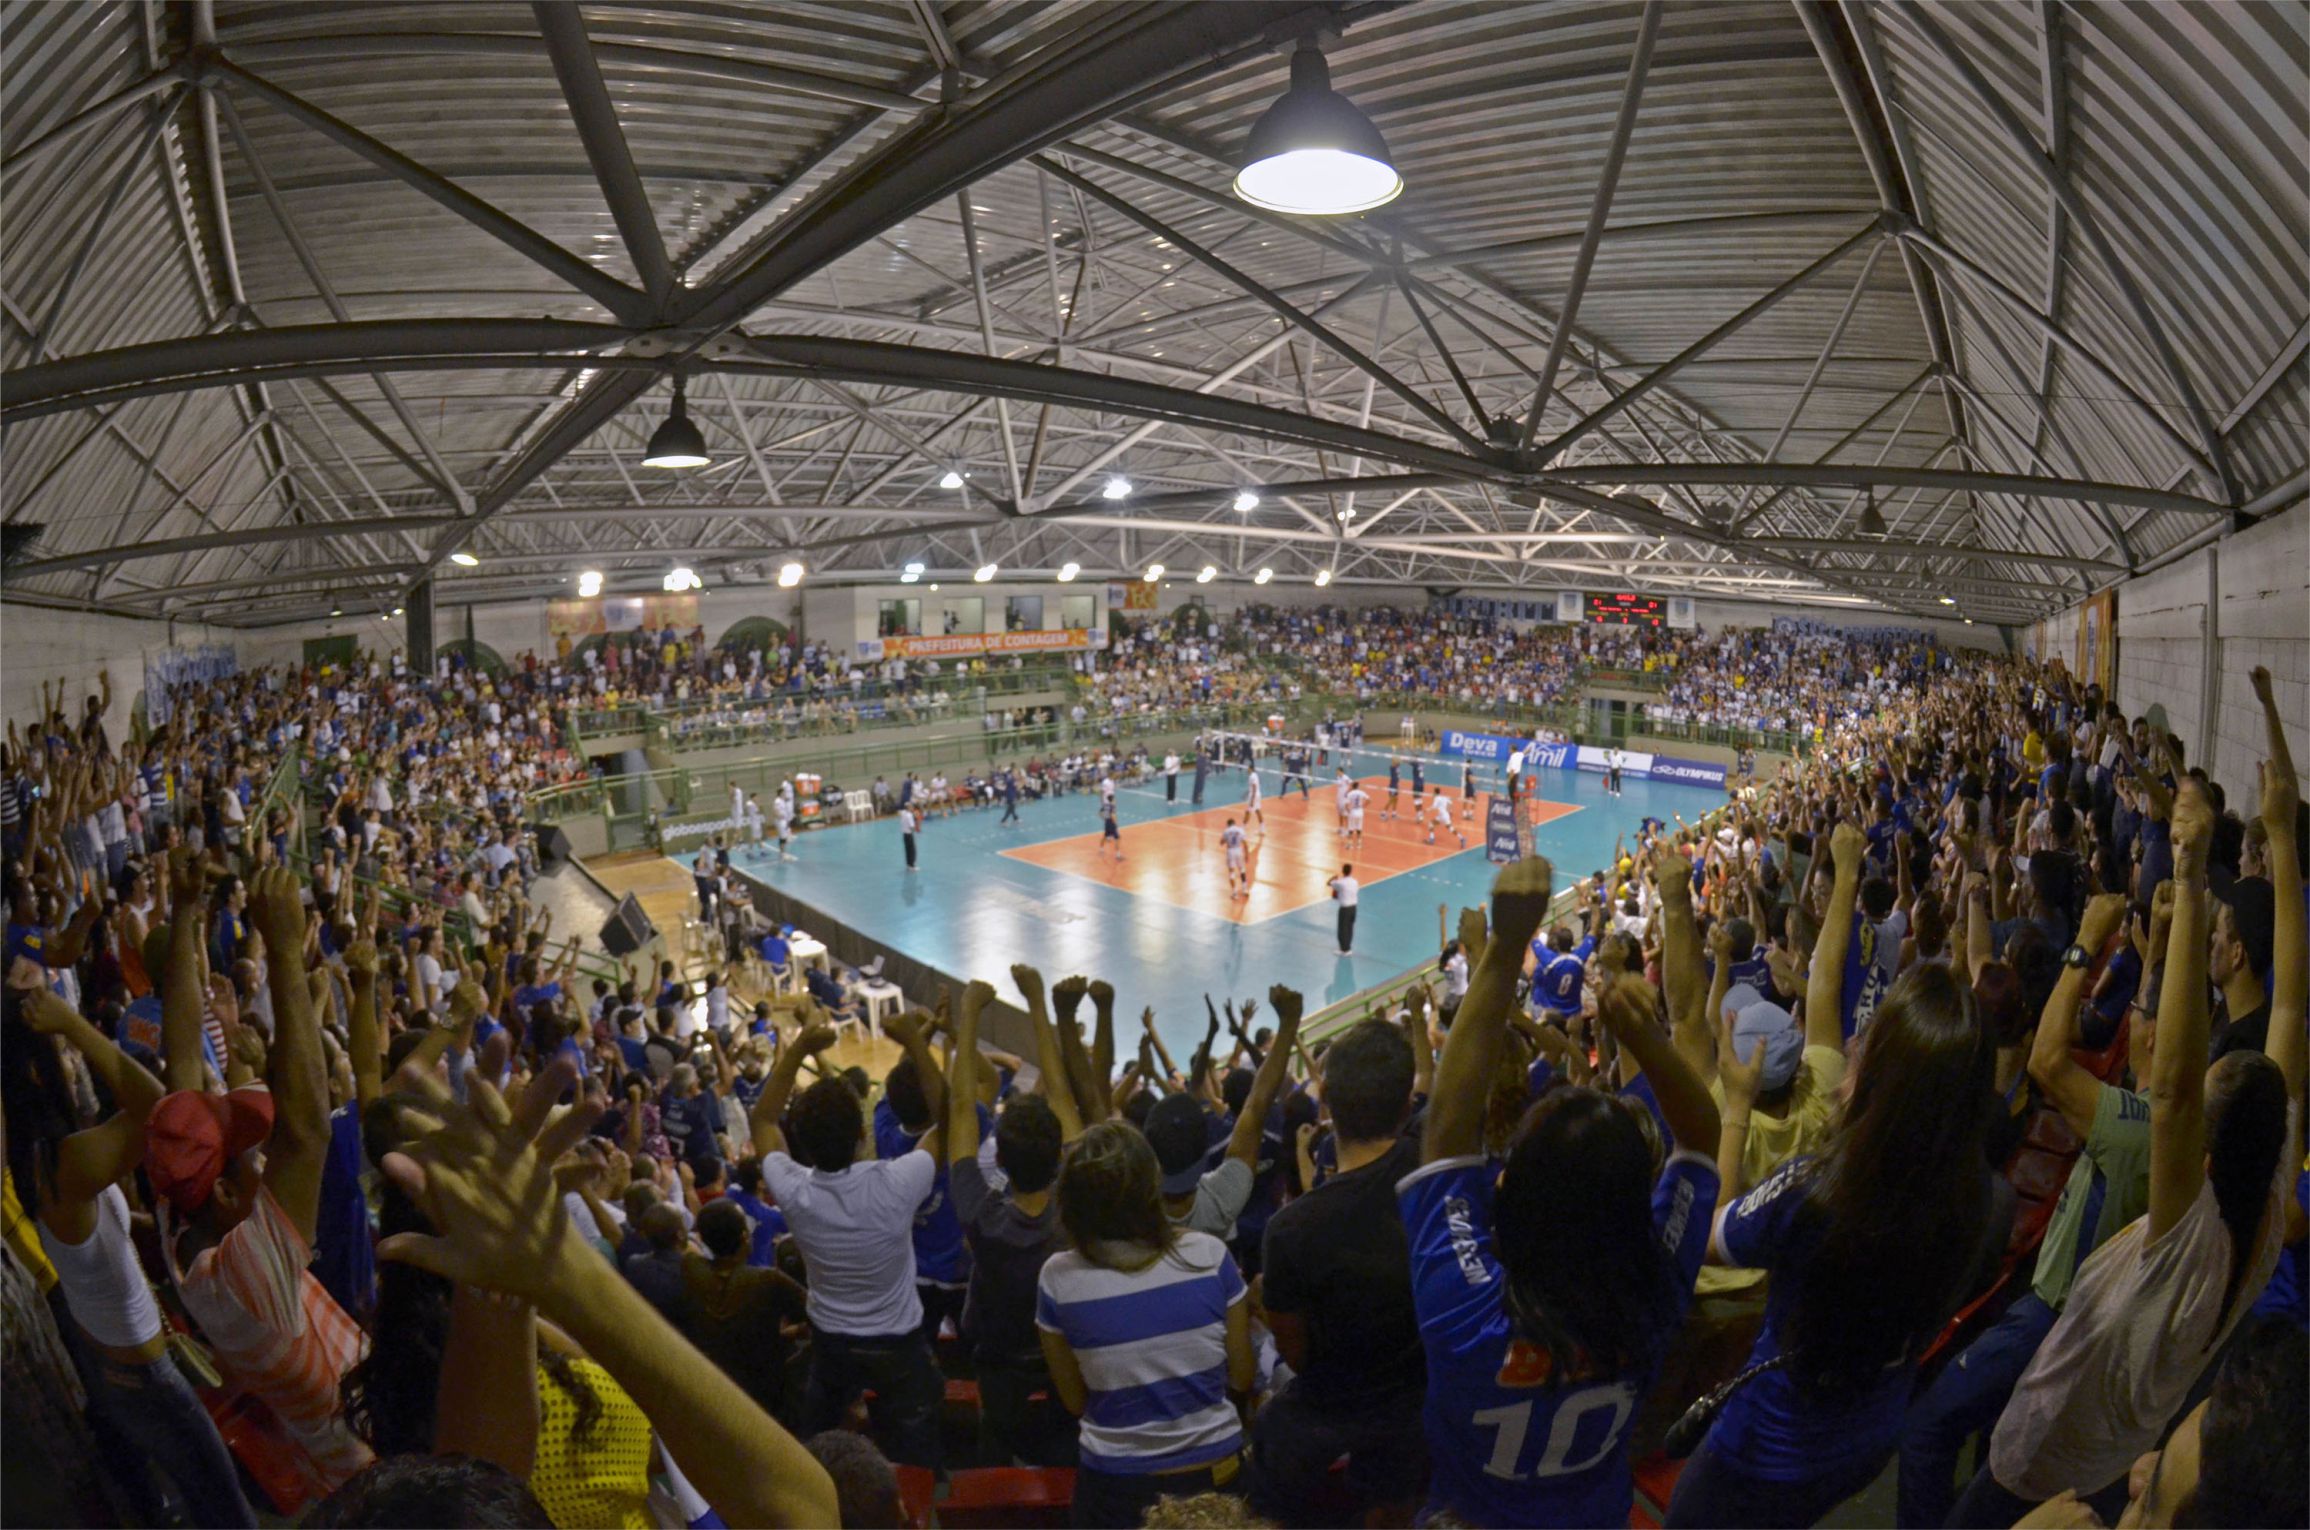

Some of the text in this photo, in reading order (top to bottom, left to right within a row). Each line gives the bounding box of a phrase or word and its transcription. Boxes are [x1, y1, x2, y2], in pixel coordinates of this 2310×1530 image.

[908, 633, 1069, 653] PREFEITURA DE CONTAGEM
[1450, 732, 1497, 751] Deva
[1523, 742, 1567, 768] Amil
[1676, 766, 1724, 782] OLYMPIKUS
[1472, 1382, 1637, 1480] 10
